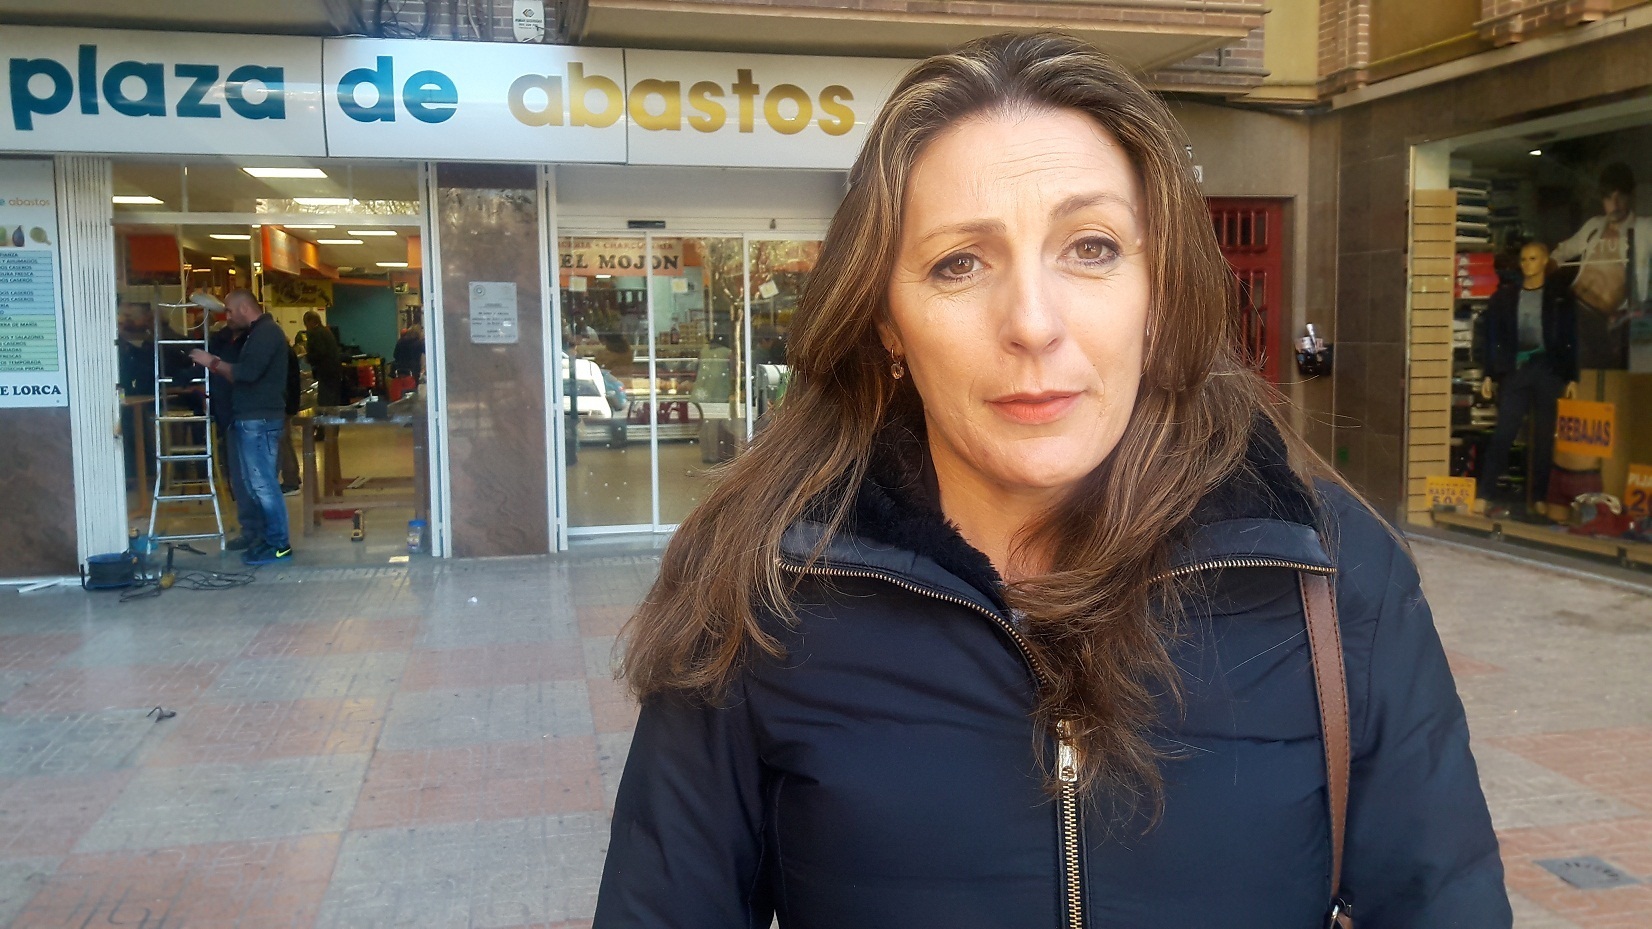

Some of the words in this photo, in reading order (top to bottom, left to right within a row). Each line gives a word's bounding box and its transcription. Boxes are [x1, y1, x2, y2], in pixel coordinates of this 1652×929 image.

[9, 44, 286, 131] plaza
[337, 55, 459, 124] de
[507, 61, 856, 137] abastos
[560, 254, 588, 269] EL
[12, 384, 62, 396] LORCA
[1558, 415, 1611, 446] REBAJAS
